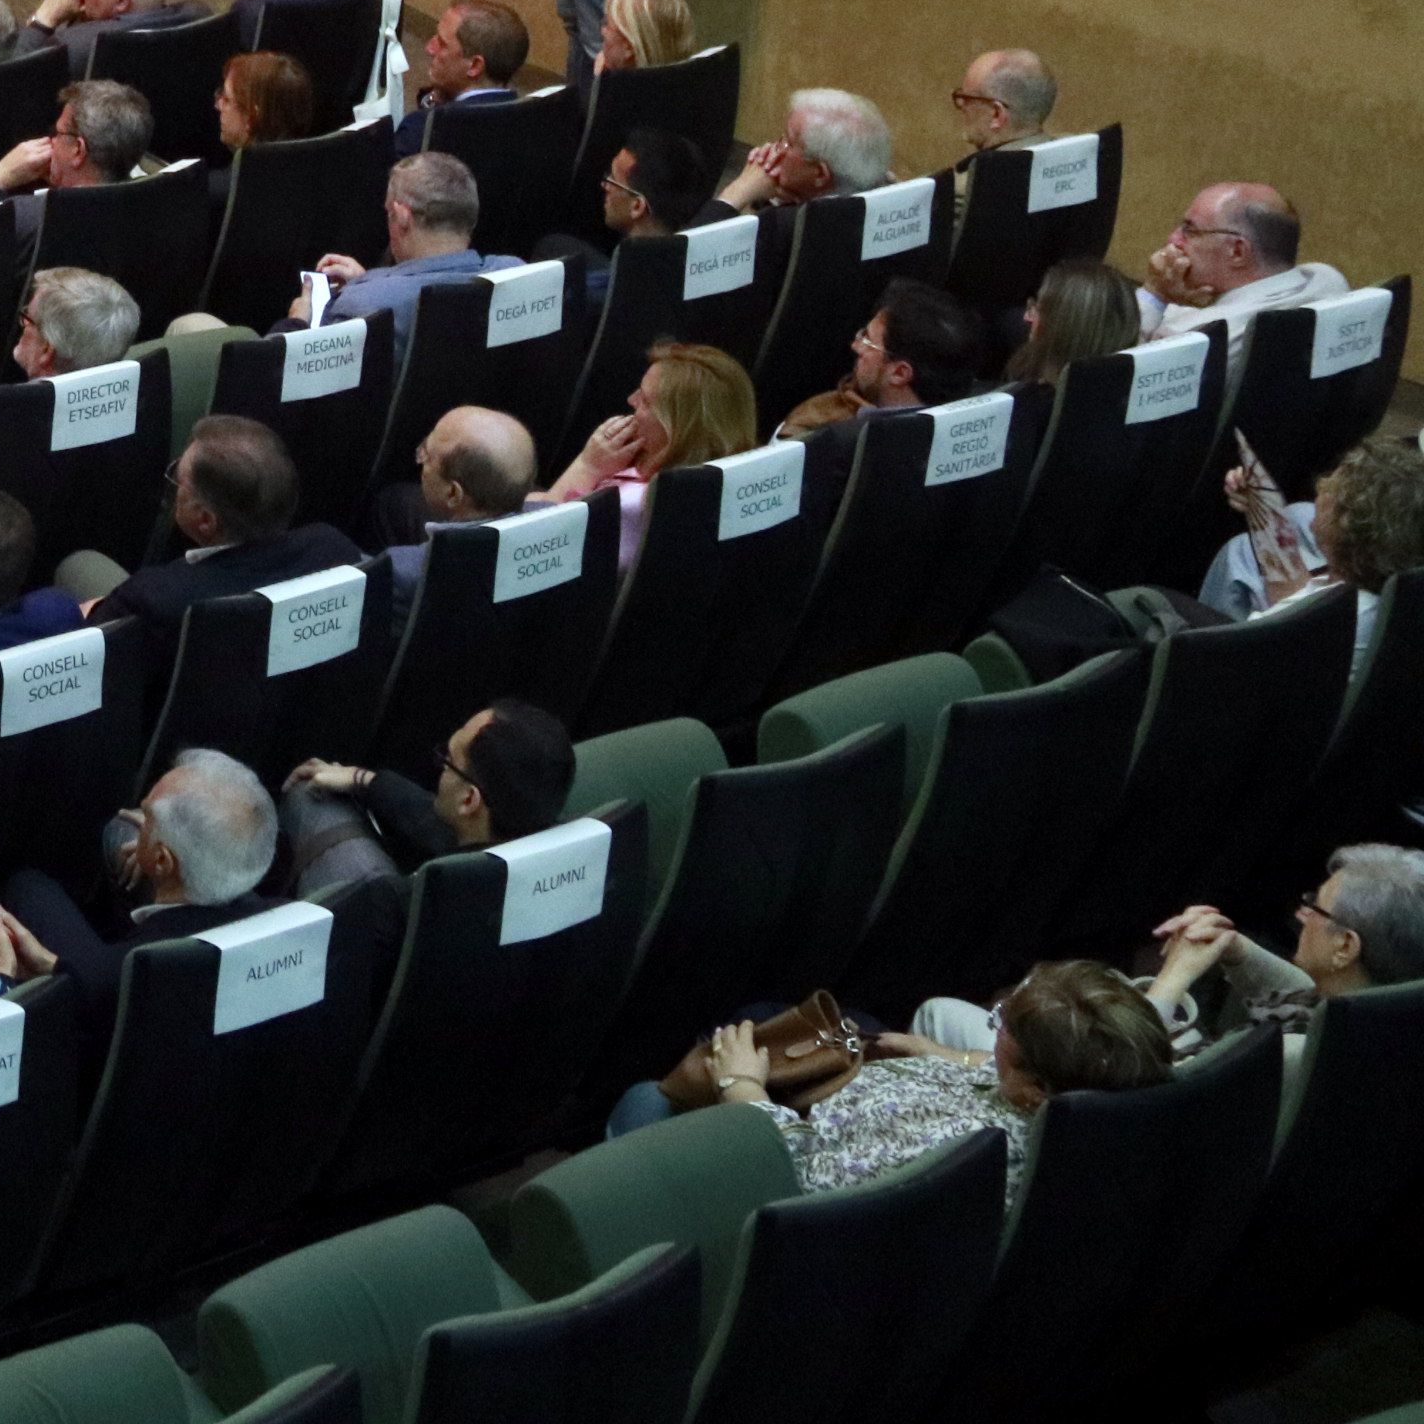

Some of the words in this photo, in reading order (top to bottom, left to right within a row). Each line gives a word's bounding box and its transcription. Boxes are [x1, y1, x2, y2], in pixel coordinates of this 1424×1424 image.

[1042, 157, 1087, 178] REGIDOR
[1054, 179, 1074, 194] ERC
[877, 204, 921, 225] ALCALDE
[873, 220, 921, 242] ALGUAIRE
[531, 295, 556, 313] FDET
[304, 335, 353, 356] DEGANA
[297, 352, 354, 373] MEDICINA
[67, 379, 130, 405] DIRECTOR
[69, 398, 126, 423] ETSEAFIV
[950, 415, 996, 438] GERENT
[736, 473, 788, 500] CONSELL
[740, 495, 783, 518] SOCIAL
[513, 534, 570, 561] CONSELL
[517, 556, 563, 580] SOCIAL
[288, 596, 348, 623] CONSELL
[294, 618, 341, 643] SOCIAL
[23, 653, 89, 683] CONSELL
[29, 676, 81, 703] SOCIAL
[532, 866, 586, 896] ALUMNI
[246, 950, 303, 983] ALUMNI
